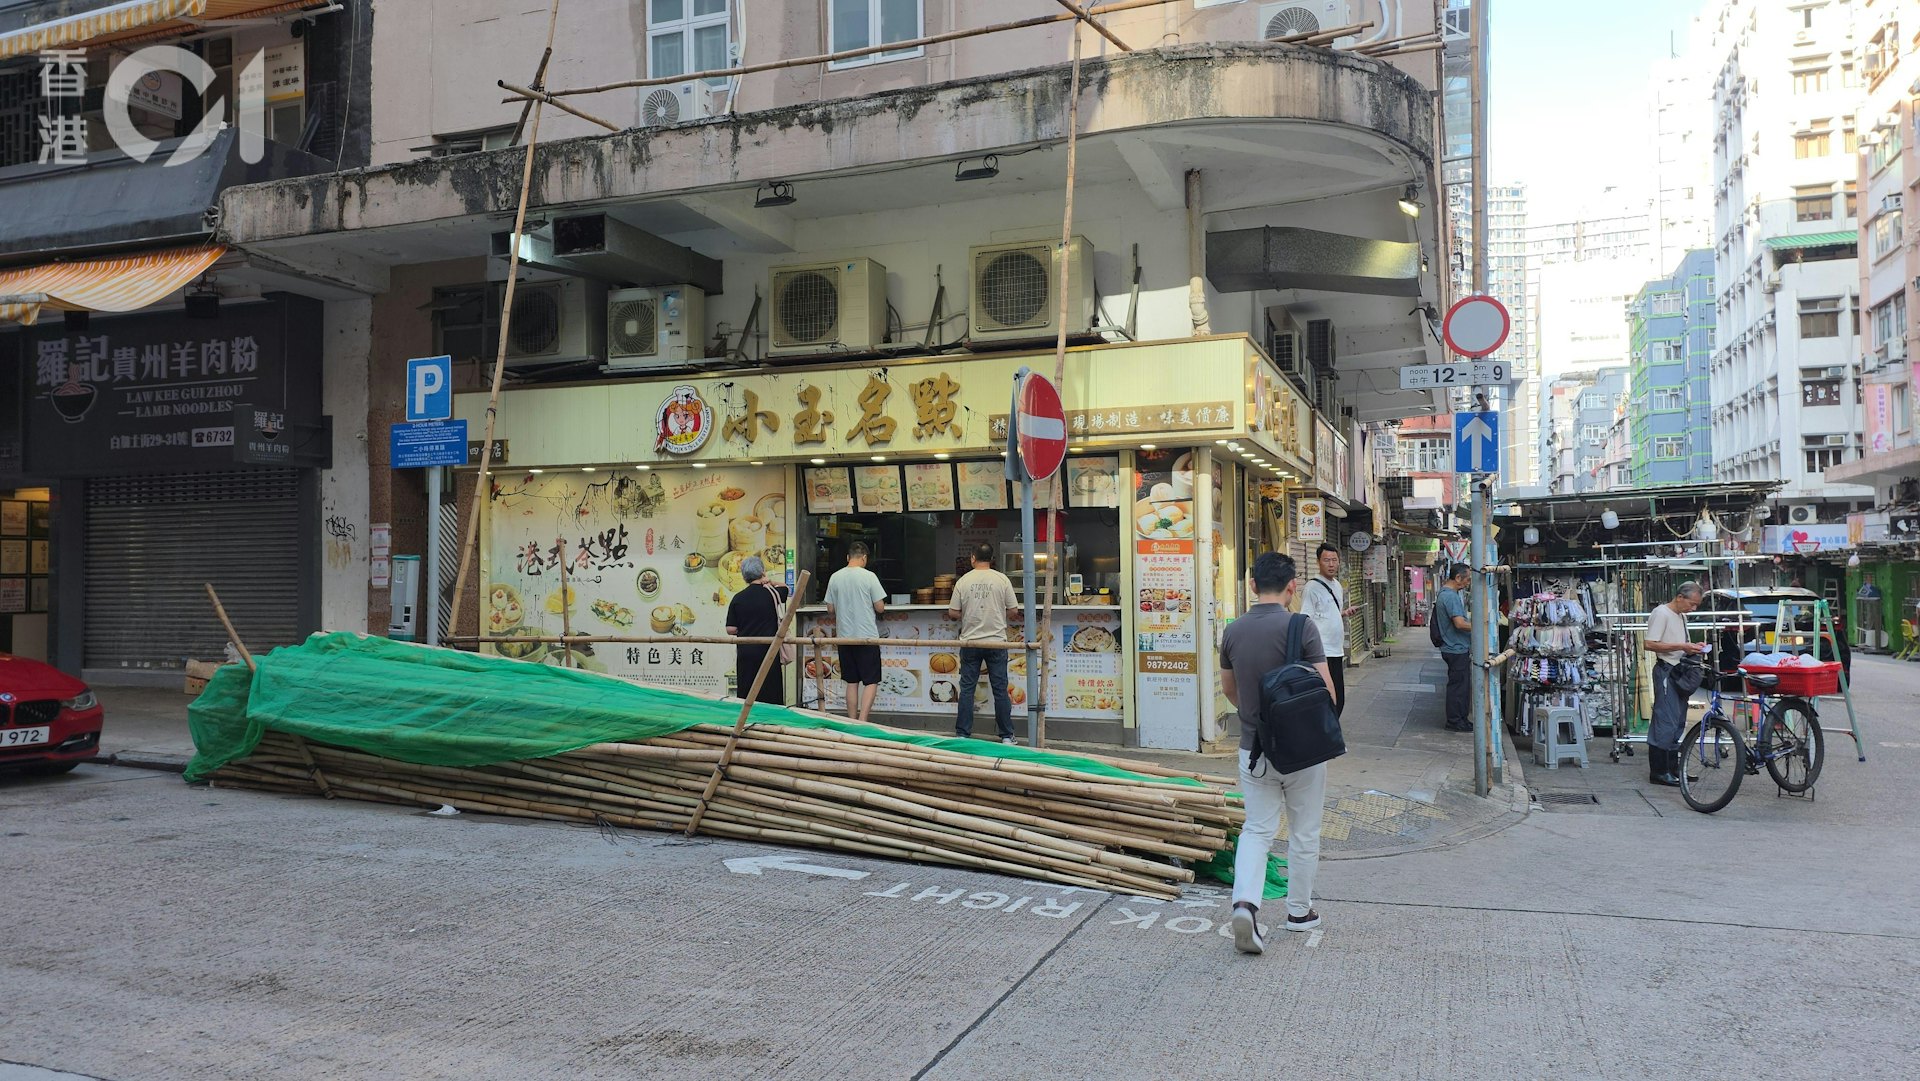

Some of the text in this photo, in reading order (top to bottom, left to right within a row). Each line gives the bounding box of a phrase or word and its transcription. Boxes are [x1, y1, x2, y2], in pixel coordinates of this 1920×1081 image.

[1409, 376, 1428, 386] 中午
[1470, 372, 1489, 385] 下午
[1493, 365, 1503, 381] 9
[126, 384, 244, 404] LAW KEE GUIZHOU
[415, 364, 444, 415] P
[136, 400, 234, 418] LAMB NOODLES
[469, 442, 502, 458] 四店
[658, 534, 685, 551] 美食
[626, 647, 704, 666] 特色美食
[1146, 661, 1189, 670] 98792402
[9, 729, 40, 744] 972
[862, 882, 1087, 919] RIGHT
